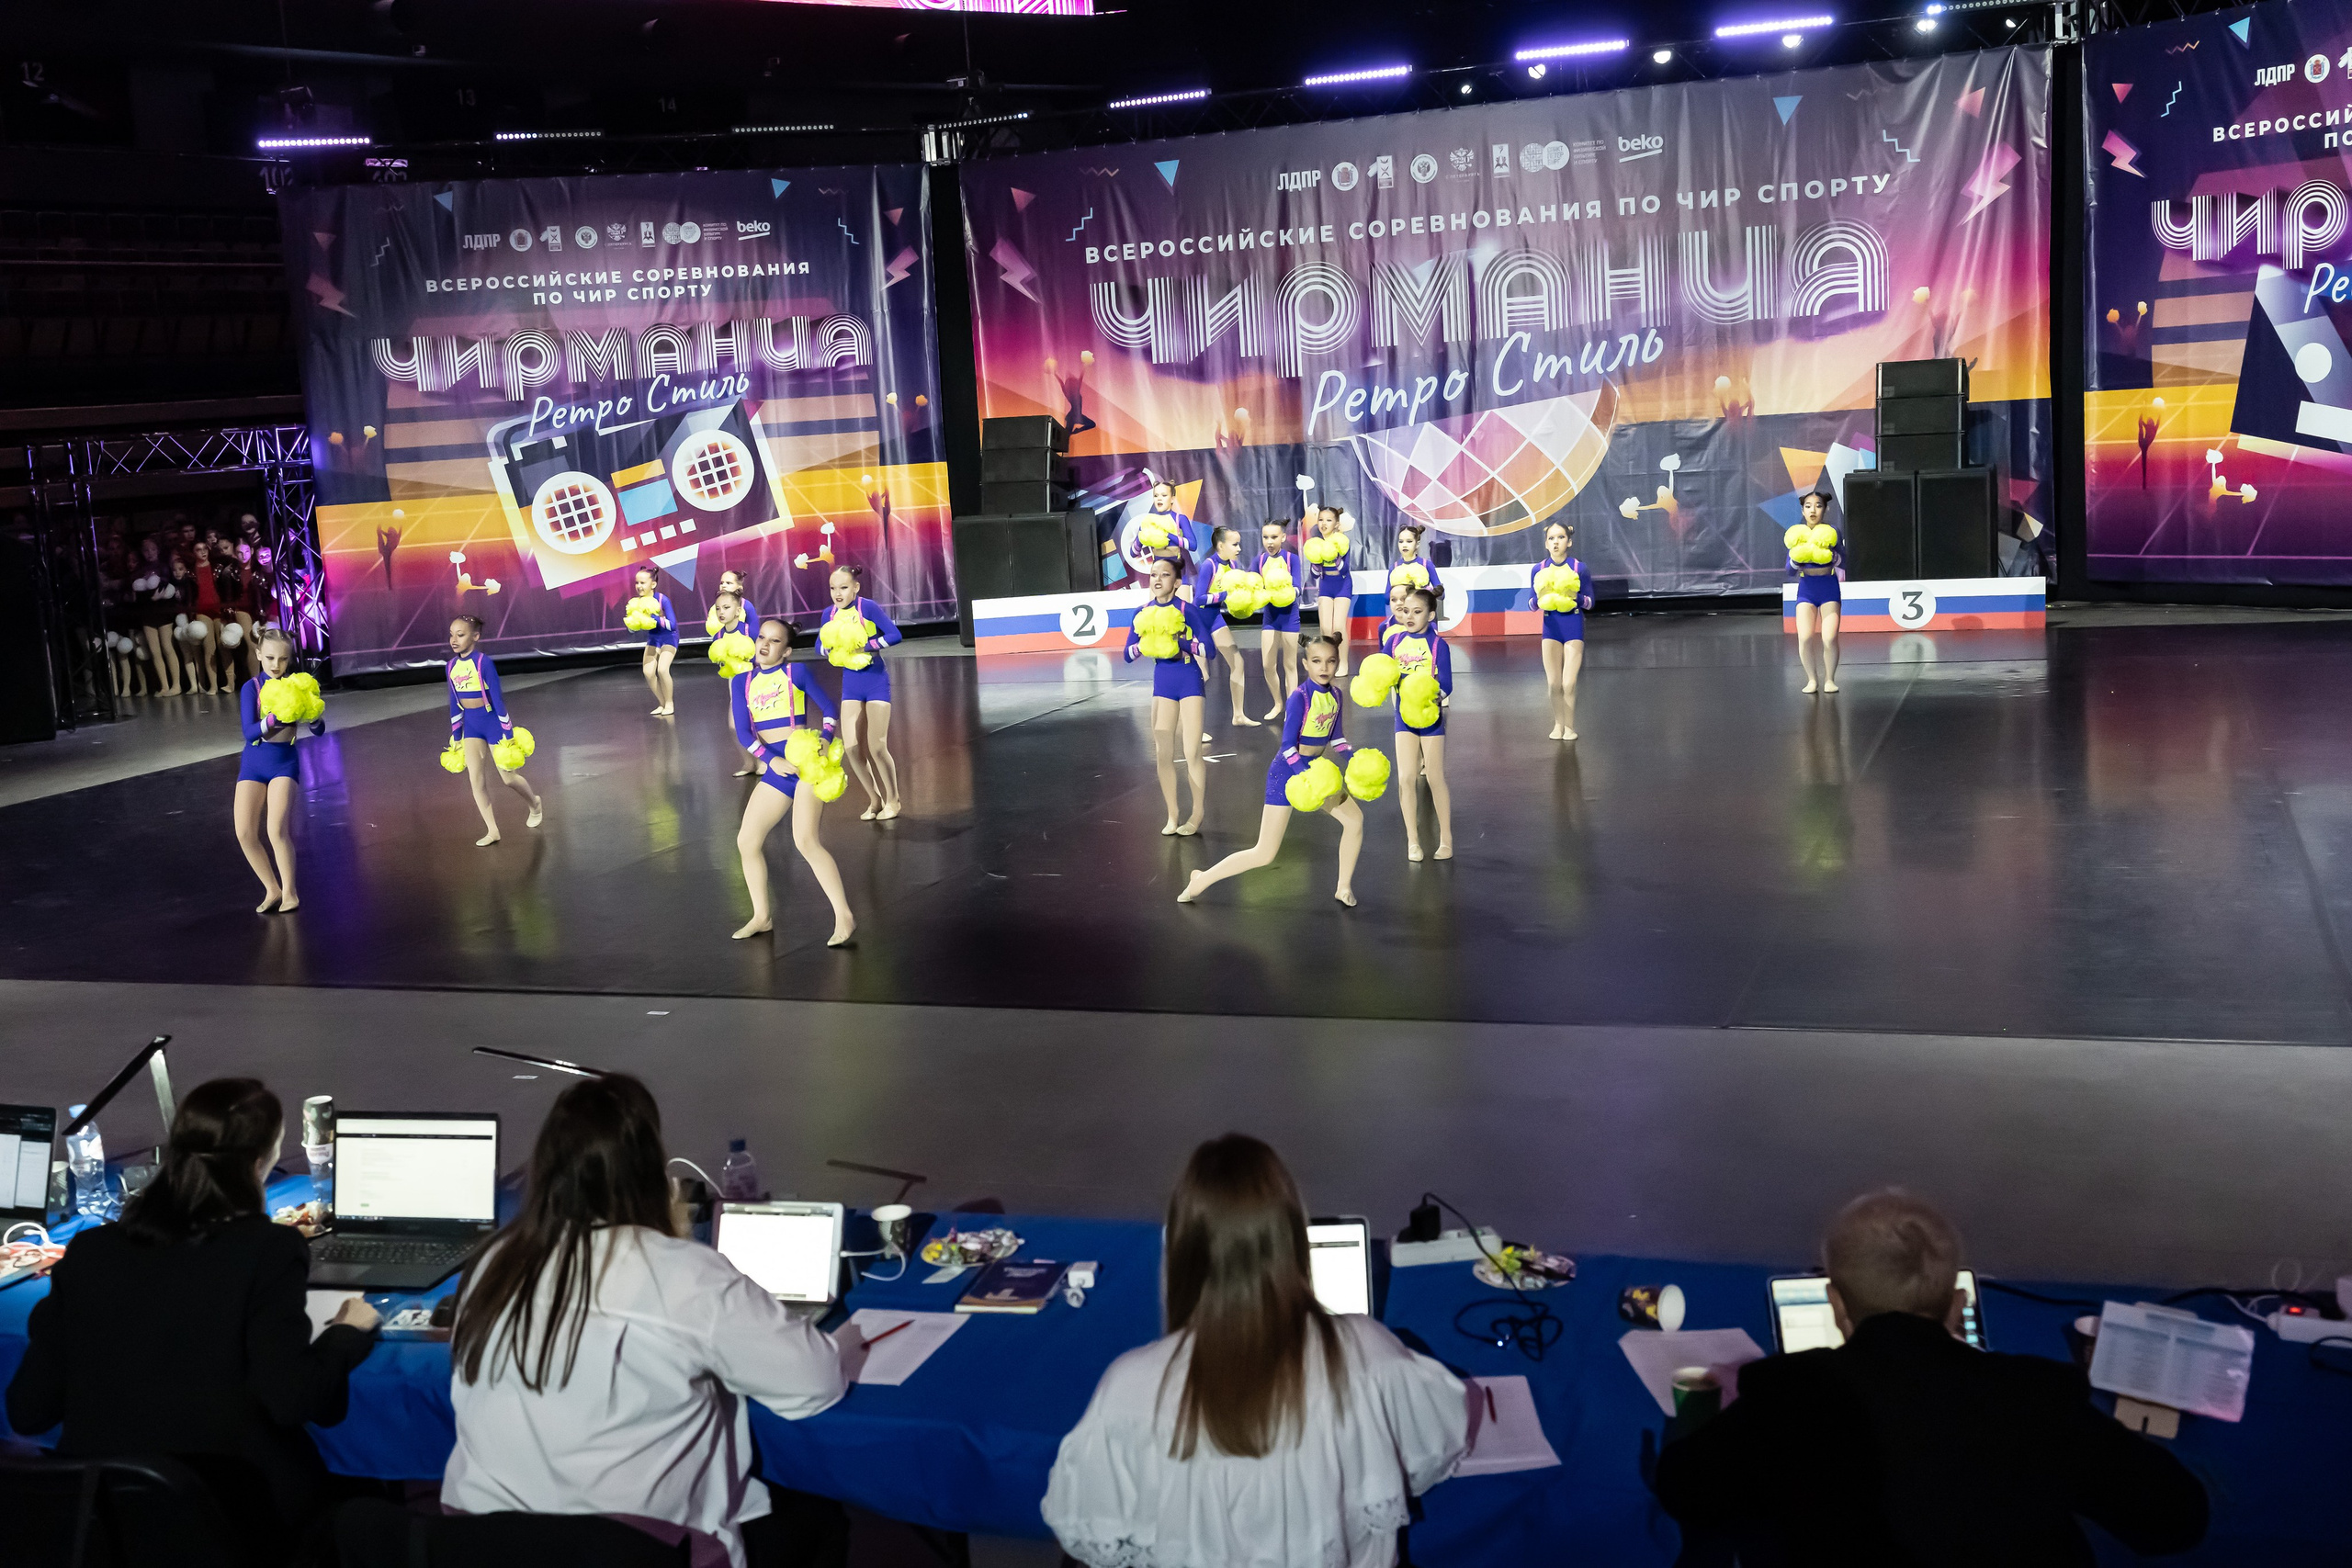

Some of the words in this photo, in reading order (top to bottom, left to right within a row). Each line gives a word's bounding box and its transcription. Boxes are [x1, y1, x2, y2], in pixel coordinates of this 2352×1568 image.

[21, 61, 45, 81] 12
[2254, 63, 2295, 87] ЛДПР
[1617, 134, 1664, 152] beko
[1277, 170, 1321, 192] ЛДПР
[737, 220, 771, 233] beko
[1084, 223, 1335, 265] ВСЕРОССИЙСКИЕ
[1348, 199, 1602, 241] СОРЕВНОВАНИЯ
[1619, 195, 1661, 216] ПО
[1677, 186, 1741, 210] ЧИР
[1758, 173, 1891, 203] СПОРТУ
[462, 233, 502, 251] ЛДПР
[425, 268, 623, 293] ВСЕРОССИЙСКИЕ
[631, 260, 811, 284] СОРЕВНОВАНИЯ
[2303, 263, 2352, 314] Ре
[532, 290, 569, 305] ПО
[572, 287, 618, 302] ЧИР
[627, 282, 714, 301] СПОРТУ
[1307, 367, 1470, 435] Ретро
[1492, 328, 1665, 397] Стиль
[528, 395, 633, 437] Ретро
[646, 371, 750, 415] Стиль
[1901, 591, 1924, 621] 3
[1071, 604, 1096, 637] 2
